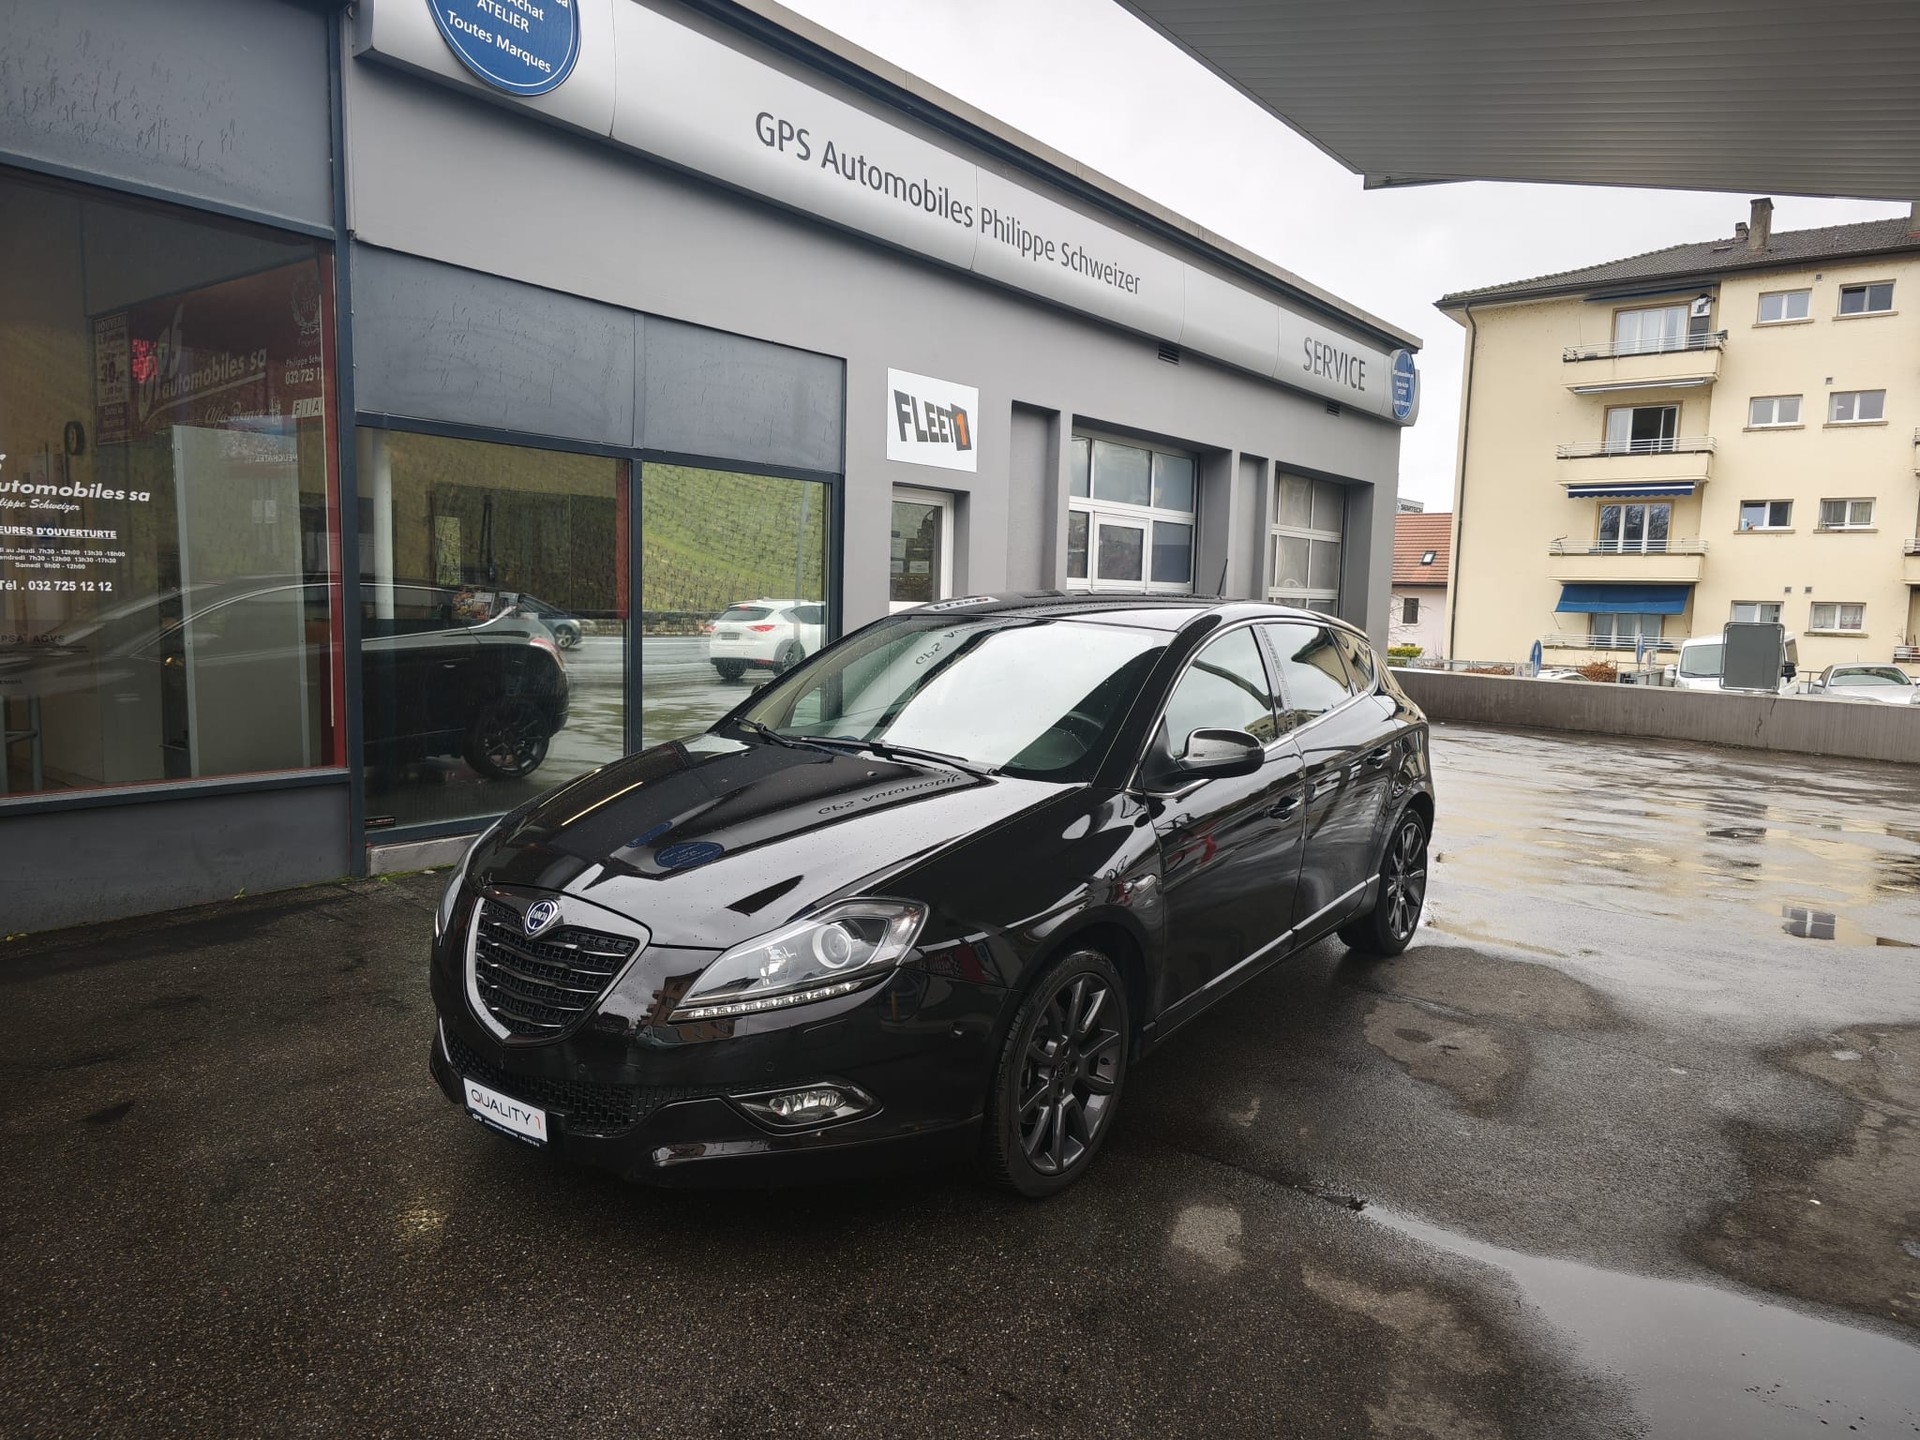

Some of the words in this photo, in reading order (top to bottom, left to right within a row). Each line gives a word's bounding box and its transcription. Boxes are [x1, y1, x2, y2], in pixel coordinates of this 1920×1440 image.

[477, 0, 529, 33] ATELIER
[447, 10, 492, 43] Toutes
[496, 34, 551, 73] Marques
[755, 111, 811, 161] GPS
[821, 140, 973, 228] Automobiles
[981, 207, 1055, 261] Philippe
[1061, 242, 1141, 294] Schweizer
[1303, 337, 1366, 391] SERVICE
[0, 480, 125, 500] utomobiles
[129, 491, 151, 502] sa
[29, 498, 80, 513] Schweizer
[36, 527, 117, 539] D'OUVERTURTE
[28, 580, 51, 591] 032
[54, 580, 77, 592] 725
[80, 581, 95, 592] 12
[98, 581, 113, 592] 12
[471, 1089, 531, 1125] QUALITY
